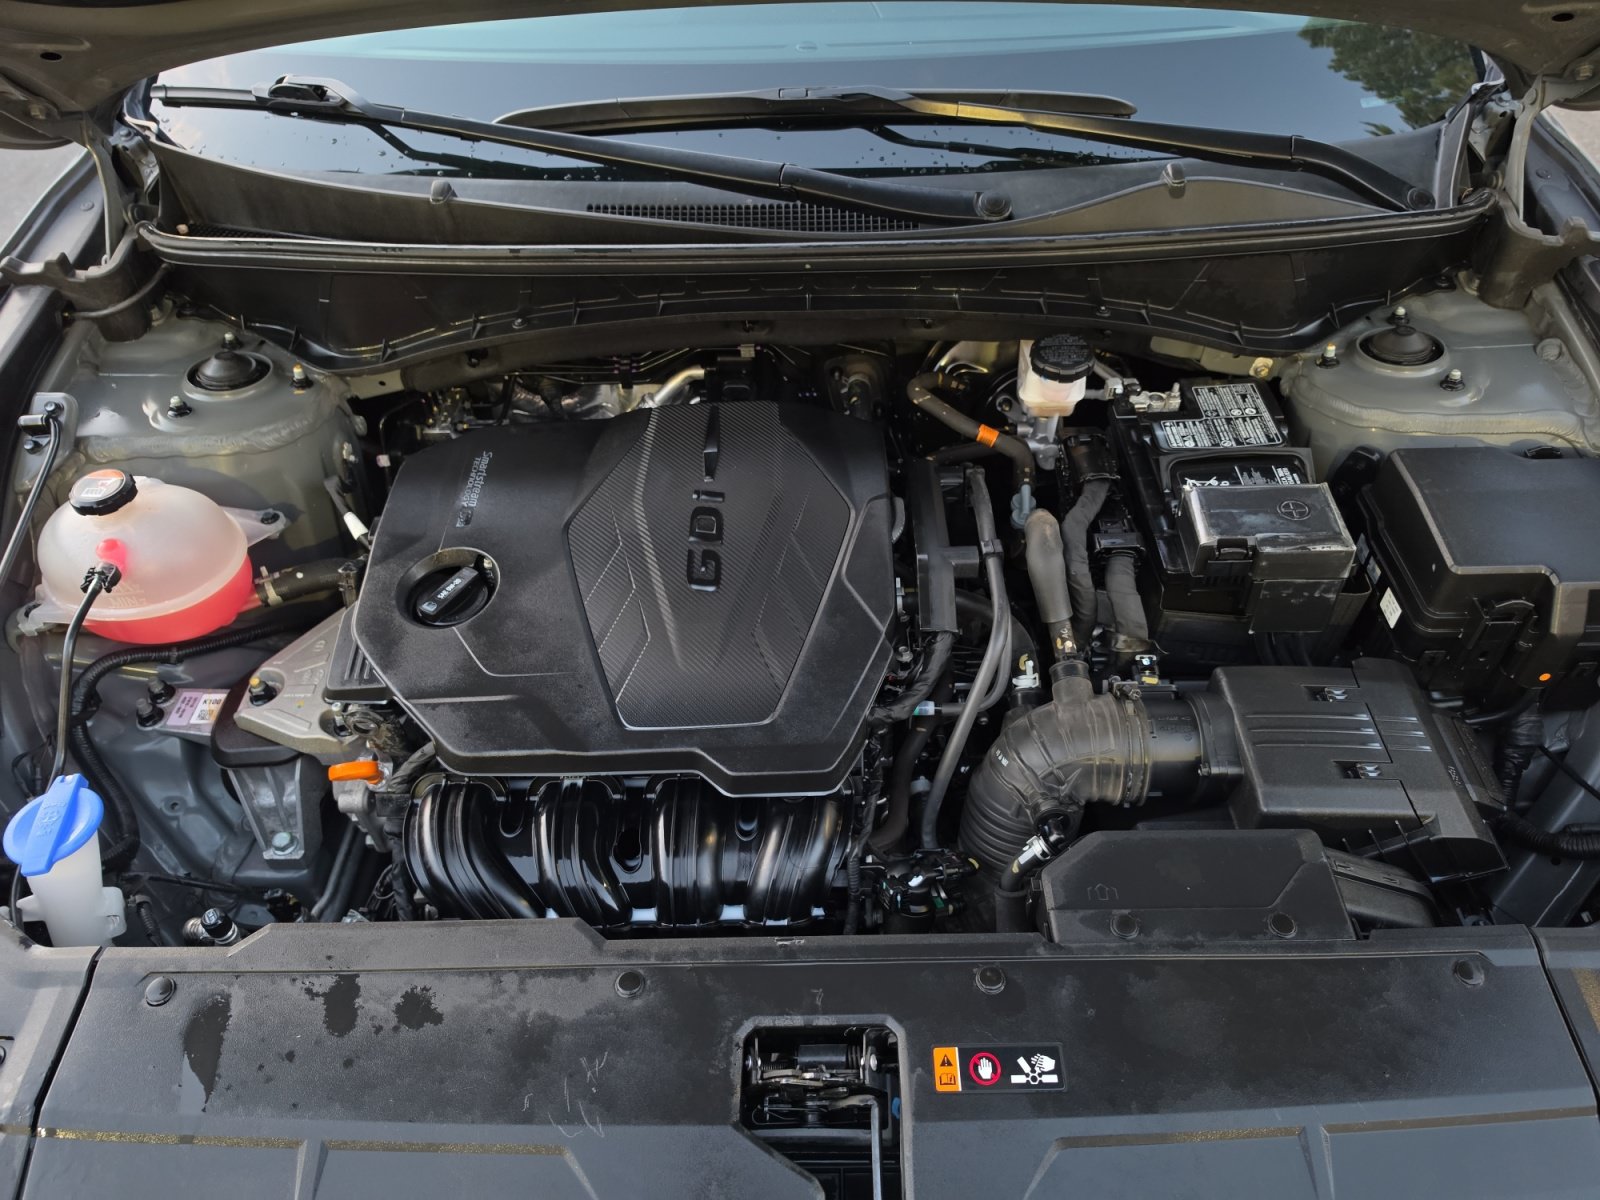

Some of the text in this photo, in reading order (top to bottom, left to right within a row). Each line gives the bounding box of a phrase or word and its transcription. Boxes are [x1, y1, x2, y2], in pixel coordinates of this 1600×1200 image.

[461, 457, 481, 507] TECHNOLOGY
[468, 450, 493, 507] Smartstream
[687, 489, 725, 592] GDi
